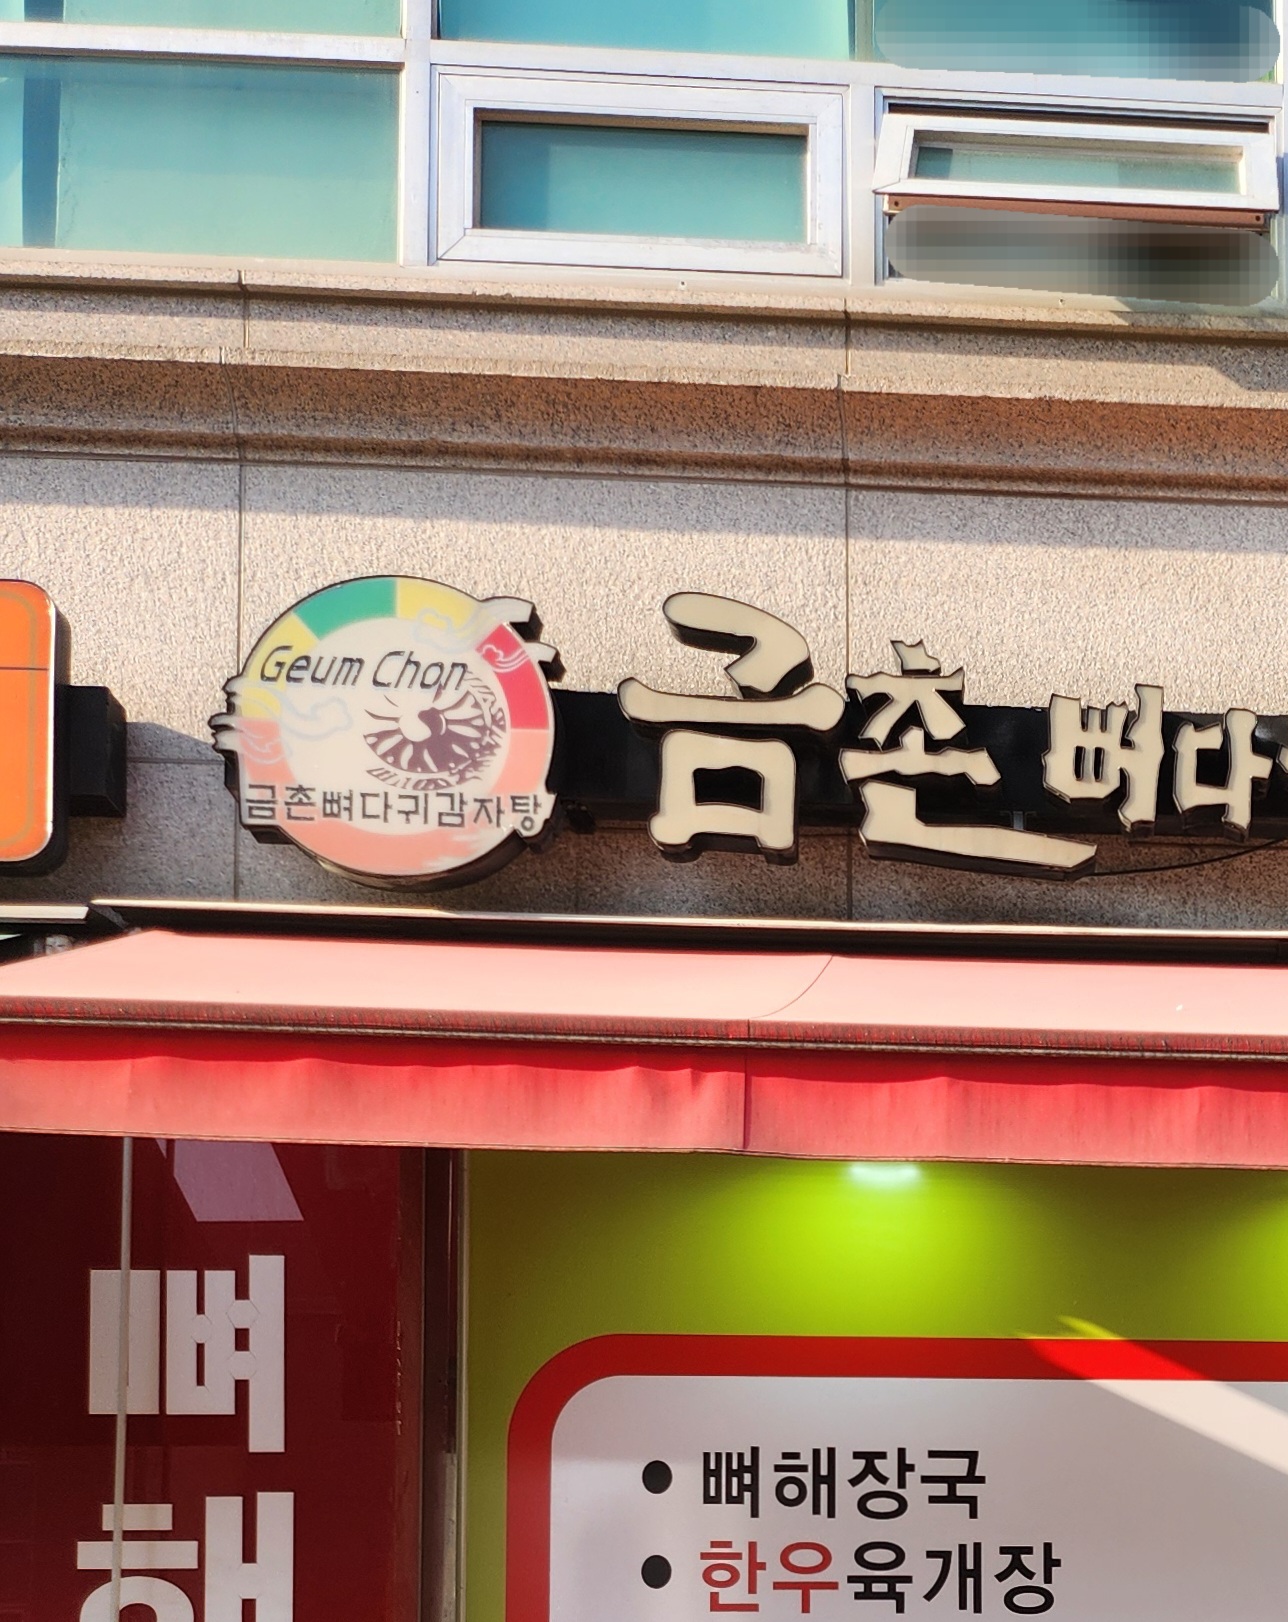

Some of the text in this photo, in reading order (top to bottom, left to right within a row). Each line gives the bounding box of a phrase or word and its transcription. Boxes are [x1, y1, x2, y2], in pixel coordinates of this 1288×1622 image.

[260, 644, 467, 692] Geum Chon
[617, 591, 1097, 877] 금촌
[244, 783, 543, 832] 금촌뼈다귀감자탕
[702, 1446, 987, 1520] 뼈해장국
[699, 1541, 1062, 1615] 한우육개장
